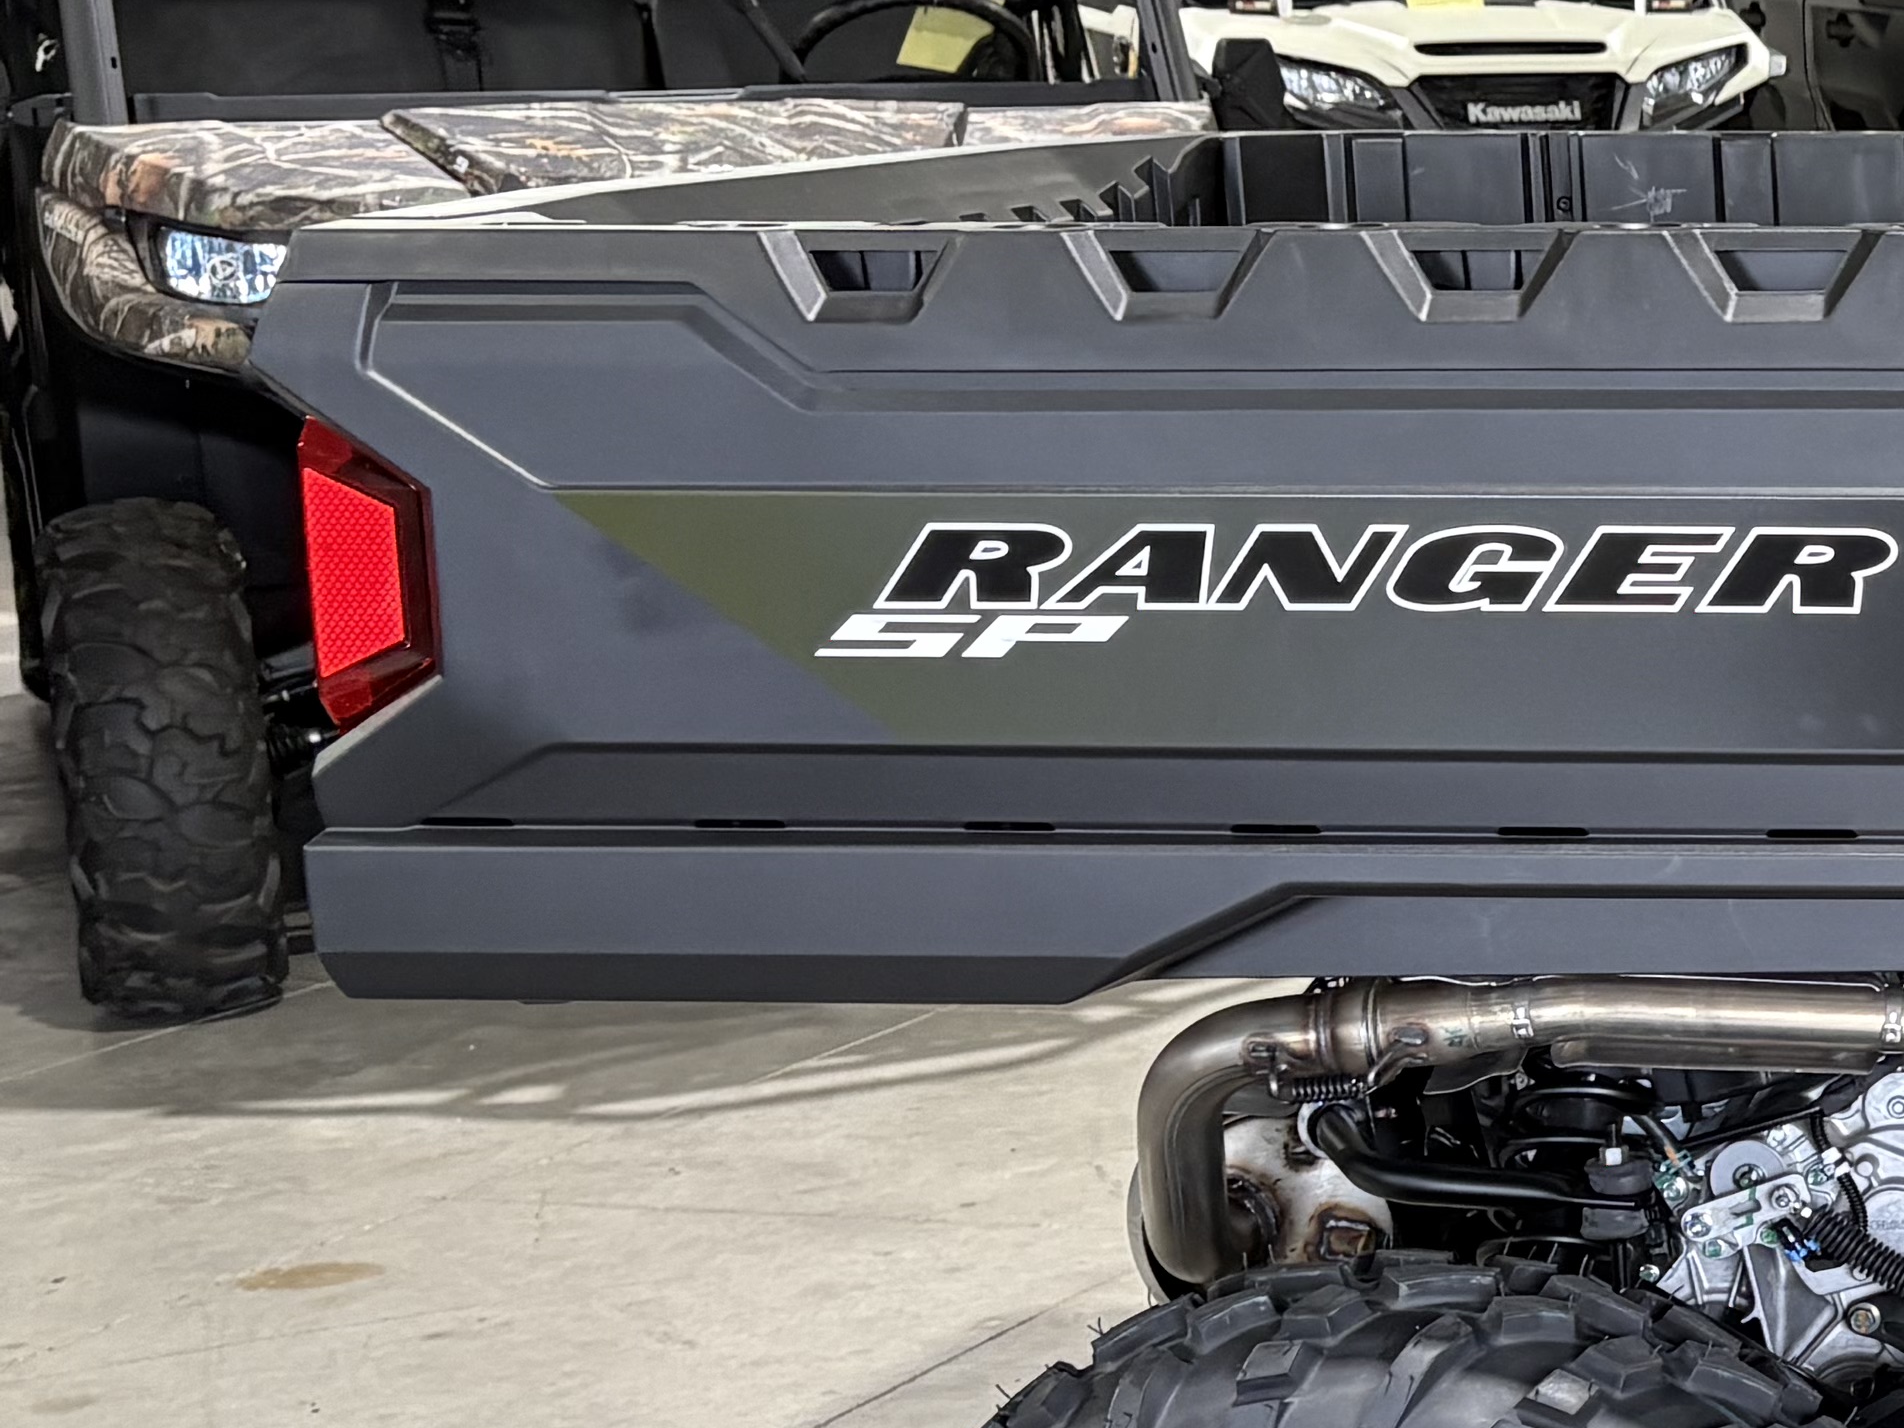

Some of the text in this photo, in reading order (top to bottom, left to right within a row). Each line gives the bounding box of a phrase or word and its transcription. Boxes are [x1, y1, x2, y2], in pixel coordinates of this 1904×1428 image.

[1467, 101, 1582, 124] Kawasaki
[874, 522, 1901, 615] RANGER
[814, 614, 1132, 658] SP
